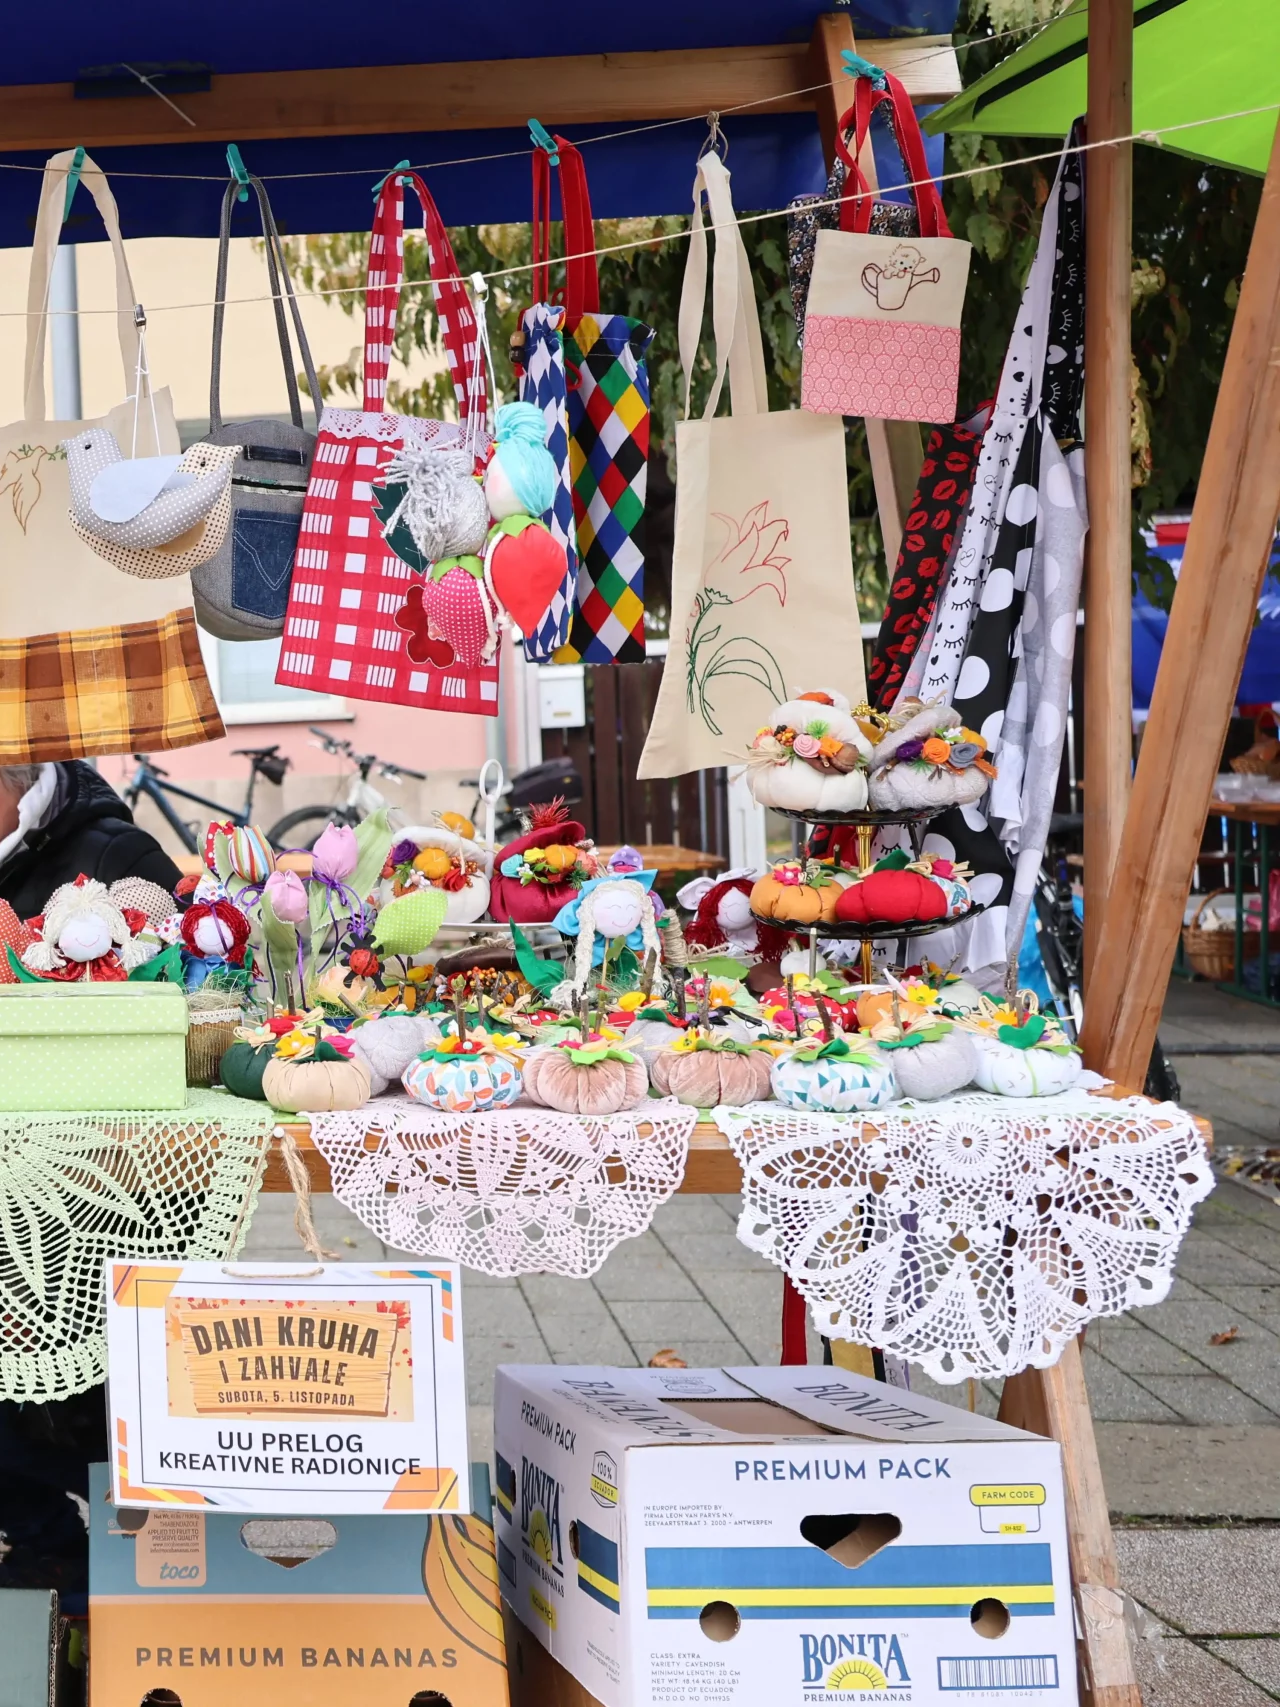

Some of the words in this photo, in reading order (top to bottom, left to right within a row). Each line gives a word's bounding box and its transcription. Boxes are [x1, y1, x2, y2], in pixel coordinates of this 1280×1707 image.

[190, 1316, 264, 1356] DANI
[278, 1315, 380, 1359] KRUHA
[218, 1360, 230, 1384] I
[238, 1356, 349, 1387] ZAHVALE
[218, 1390, 269, 1404] SUBOTA,
[273, 1390, 285, 1403] 5.
[289, 1390, 356, 1407] LISTOPADA
[562, 1379, 716, 1438] BANANAS
[793, 1383, 945, 1432] BONITA
[521, 1400, 554, 1441] PREMIUM
[554, 1425, 577, 1455] PACK
[217, 1431, 253, 1451] UU
[262, 1433, 364, 1453] PRELOG
[159, 1451, 286, 1474] KREATIVNE
[291, 1456, 422, 1476] RADIONICE
[734, 1460, 867, 1481] PREMIUM
[878, 1457, 952, 1480] PACK
[593, 1480, 615, 1497] ECUADOR
[982, 1491, 1007, 1499] FARM
[1009, 1490, 1035, 1499] CODE
[521, 1455, 564, 1566] BONITA
[160, 1562, 200, 1580] toco
[541, 1569, 565, 1598] BANANAS
[136, 1646, 285, 1668] PREMIUM
[301, 1647, 459, 1668] BANANAS
[800, 1633, 912, 1682] BONITA
[803, 1693, 857, 1702] PREMIUM
[859, 1692, 912, 1702] BANANAS
